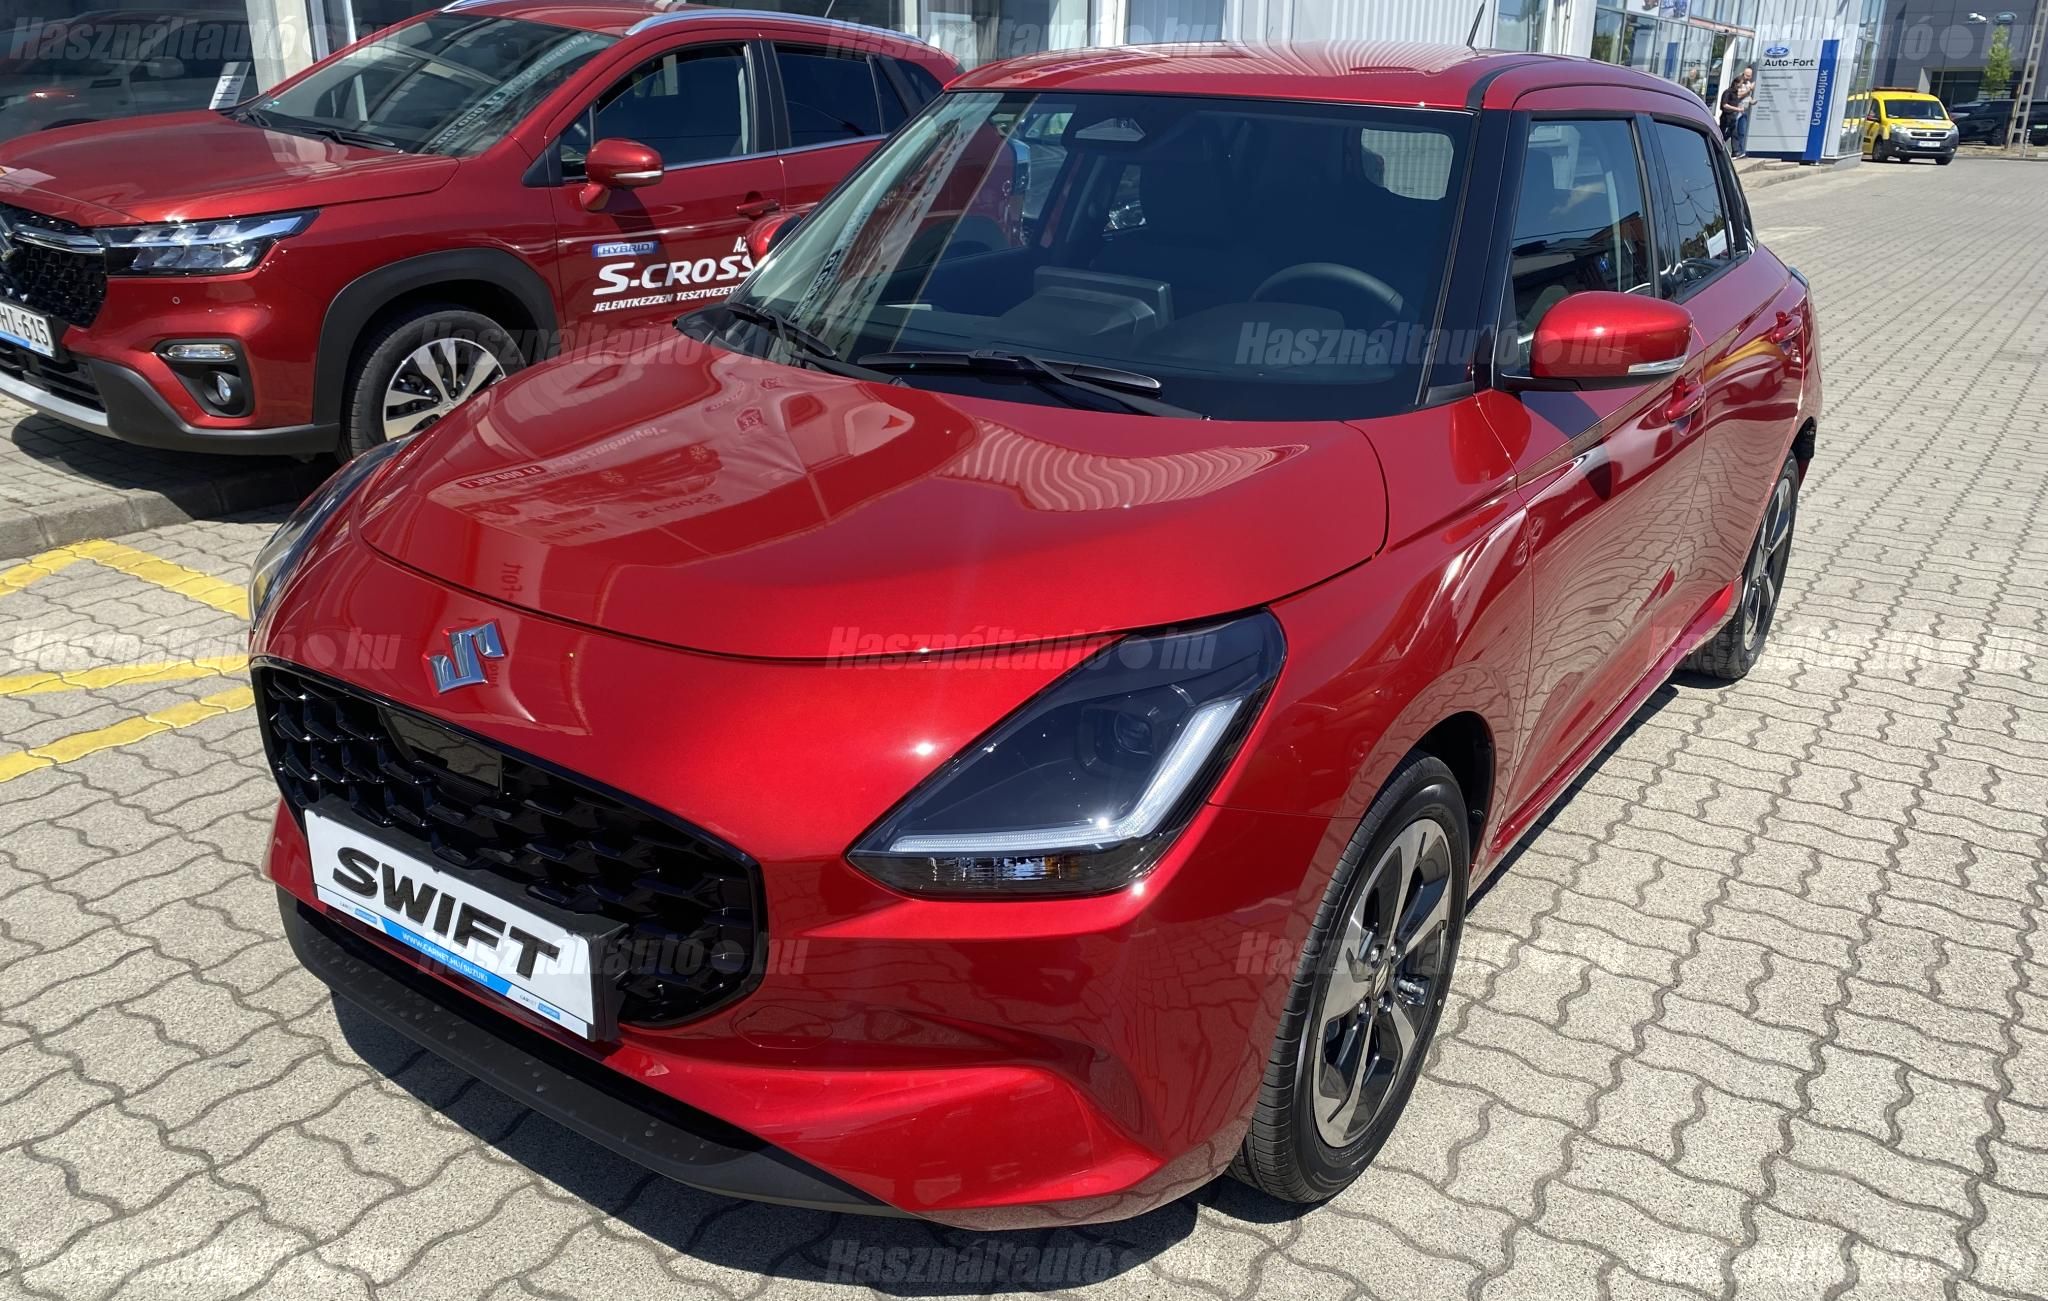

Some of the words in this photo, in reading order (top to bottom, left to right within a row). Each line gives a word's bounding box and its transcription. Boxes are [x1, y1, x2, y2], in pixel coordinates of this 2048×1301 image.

[1763, 59, 1815, 67] Auto-Fort
[1812, 69, 1829, 126] Üdvözöljük
[602, 244, 650, 255] HYBRID
[592, 293, 674, 313] JELENTKEZZEN
[332, 847, 561, 981] SWIFT
